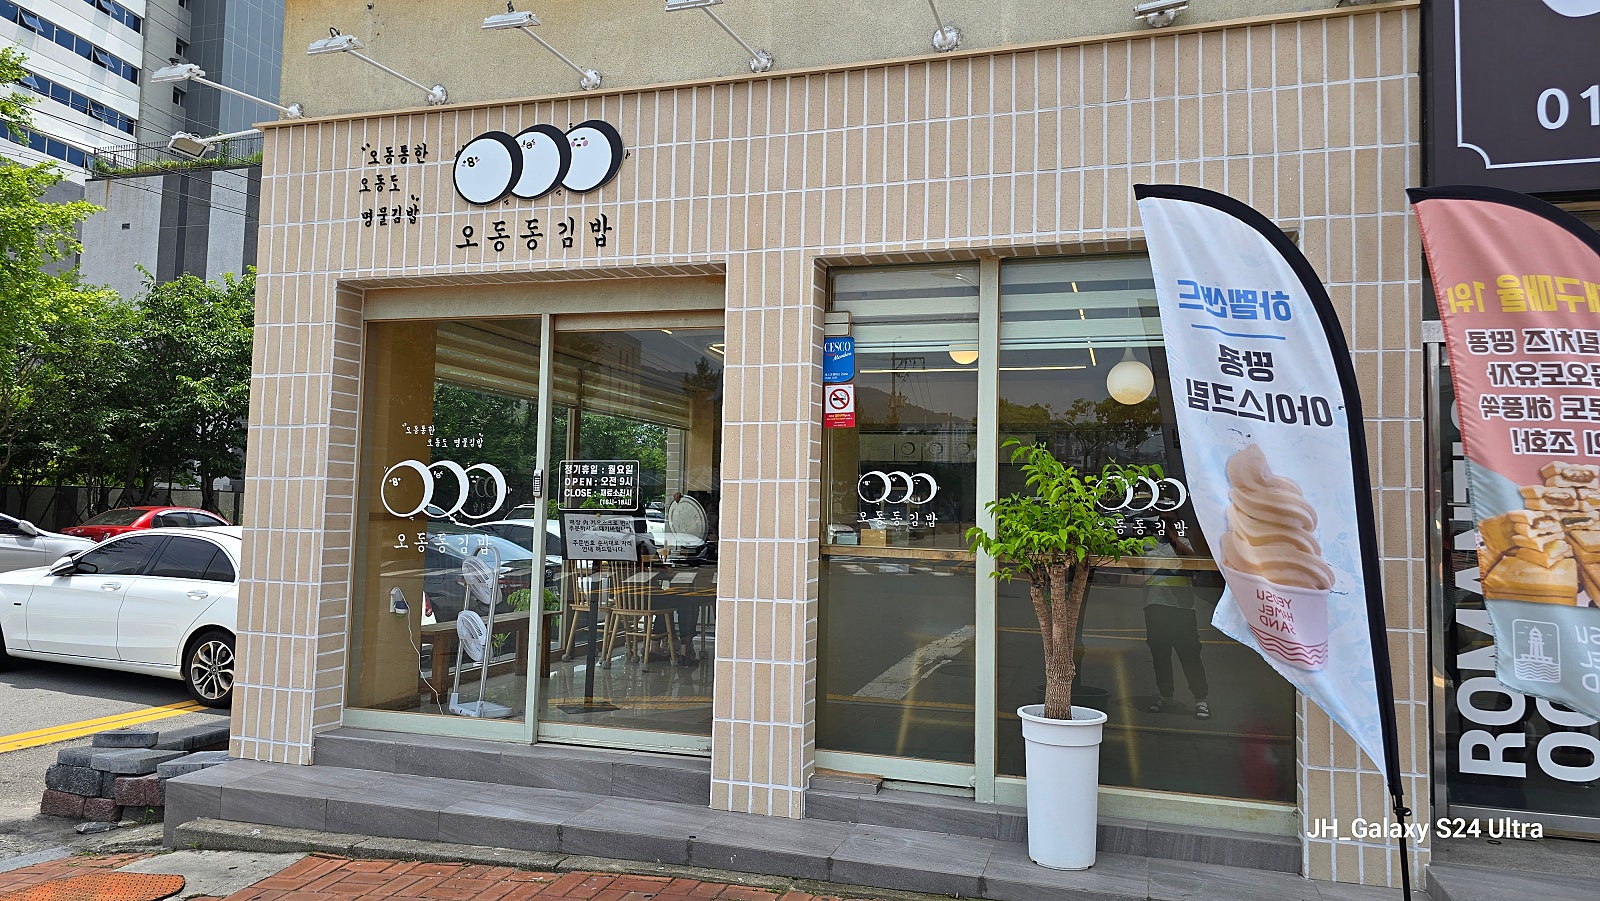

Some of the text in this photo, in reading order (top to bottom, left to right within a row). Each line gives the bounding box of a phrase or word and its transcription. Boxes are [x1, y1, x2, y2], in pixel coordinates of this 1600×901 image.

[359, 174, 401, 192] 오동도
[455, 214, 612, 252] 오동동김밥
[824, 341, 851, 352] CESCO
[427, 438, 448, 447] 오동도
[564, 465, 598, 475] 정기휴일
[608, 465, 634, 475] 월요일
[600, 476, 617, 486] 오전
[620, 477, 633, 487] 9시
[600, 489, 632, 497] 재료소진시
[857, 511, 938, 527] 오동동김밥
[394, 532, 492, 555] 오동동김밥
